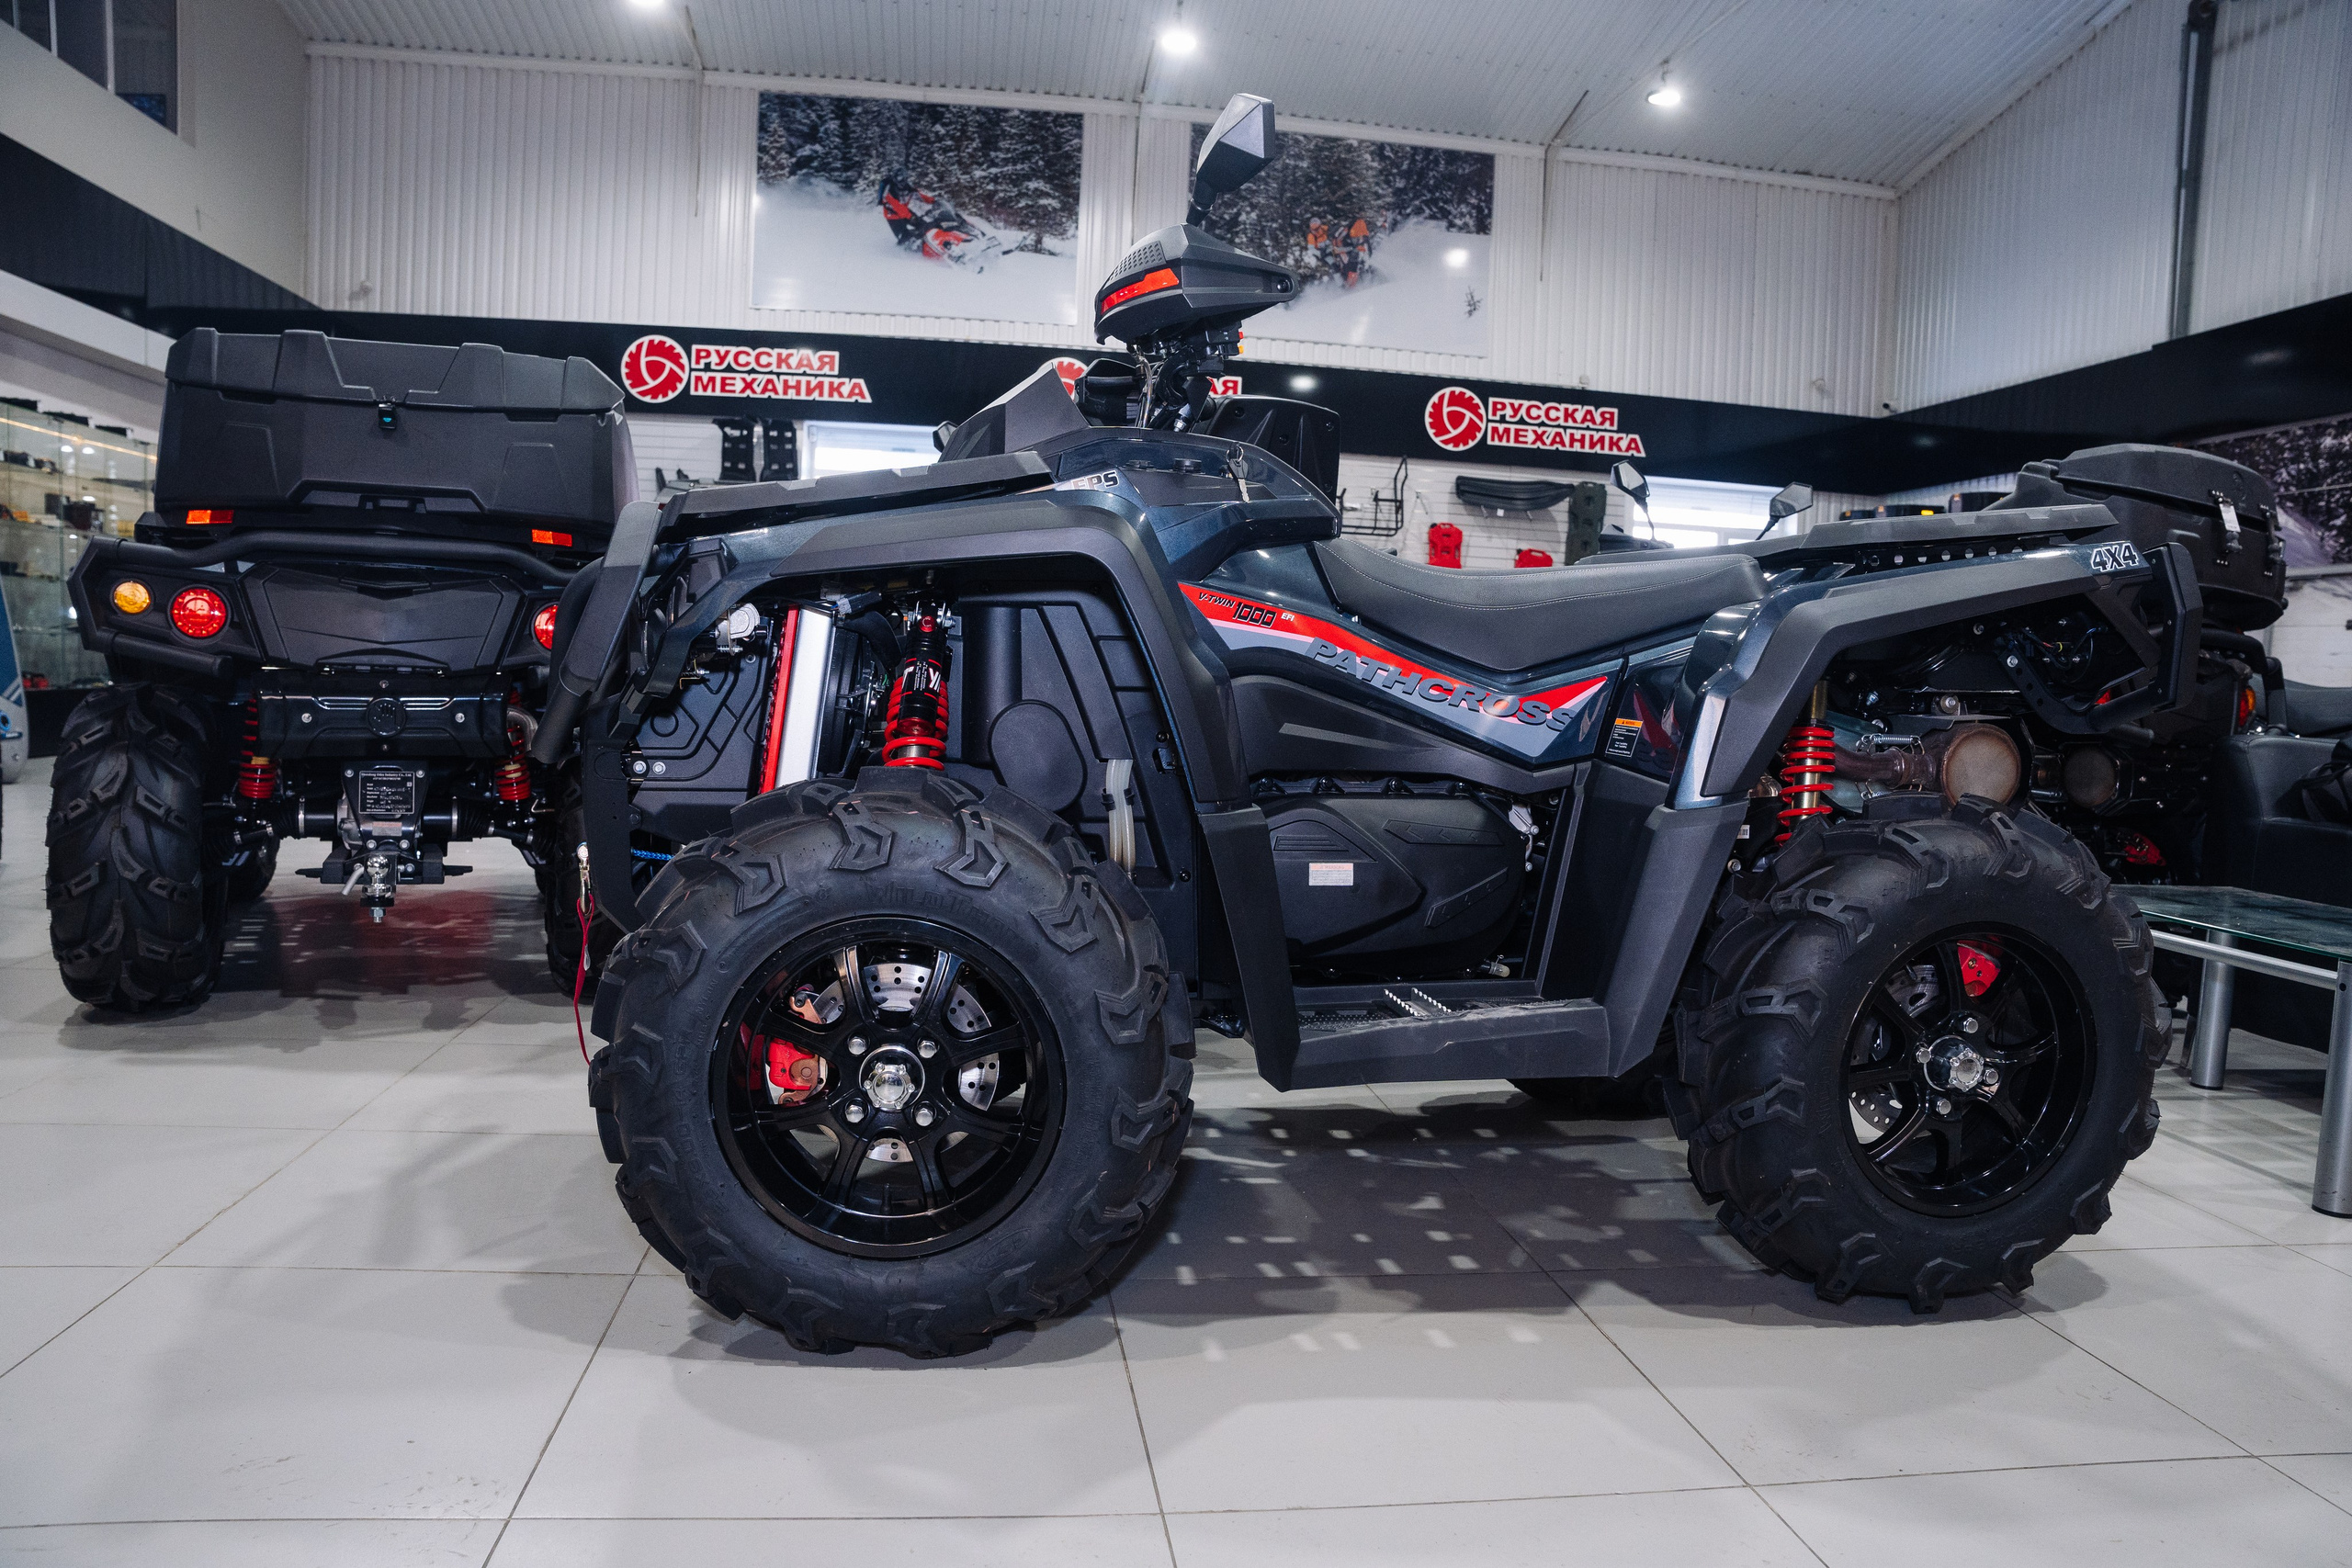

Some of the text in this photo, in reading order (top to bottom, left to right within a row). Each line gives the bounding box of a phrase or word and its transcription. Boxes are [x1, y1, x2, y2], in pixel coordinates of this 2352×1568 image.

[693, 346, 837, 373] РУССКАЯ
[692, 373, 870, 401] МЕХАНИКА
[1490, 400, 1617, 429] РУССКАЯ
[1489, 424, 1644, 456] МЕХАНИКА
[1071, 470, 1119, 490] EPS
[2091, 543, 2139, 572] 4X4
[1199, 592, 1295, 627] V-TWIN 1000 EFI
[1304, 637, 1577, 732] PATHCROSS
